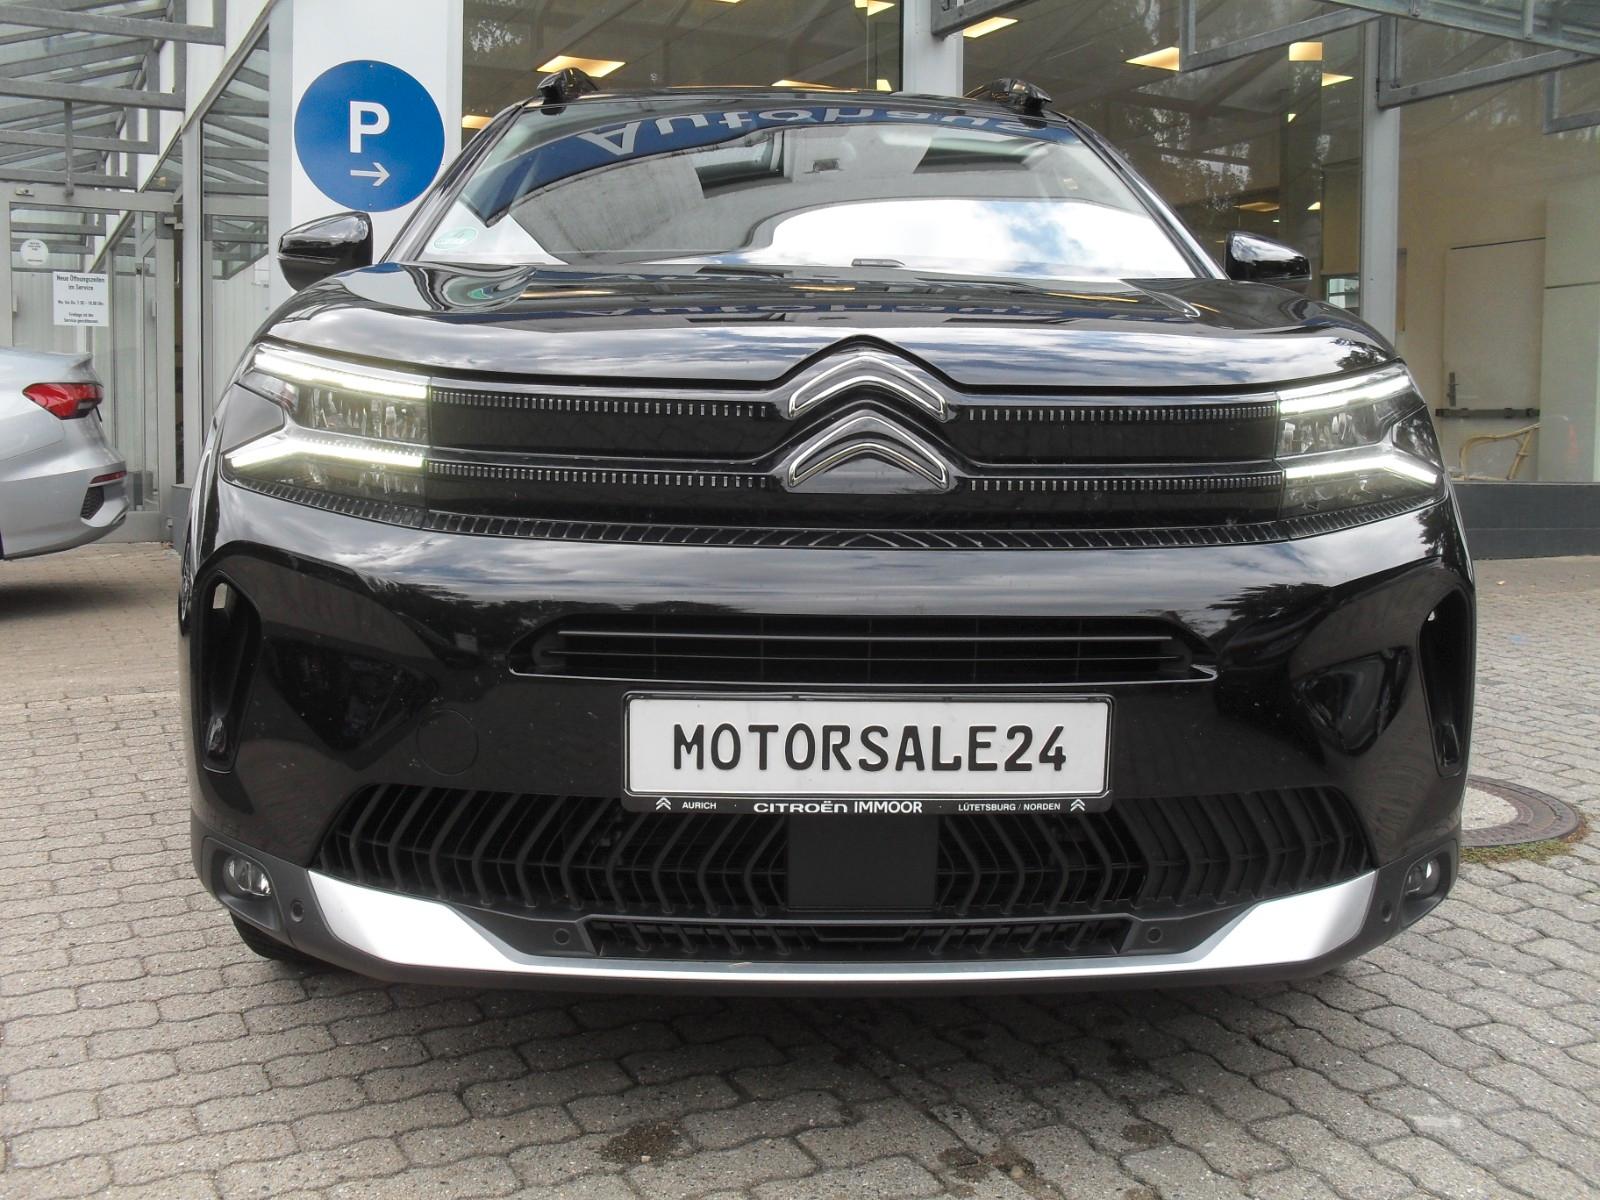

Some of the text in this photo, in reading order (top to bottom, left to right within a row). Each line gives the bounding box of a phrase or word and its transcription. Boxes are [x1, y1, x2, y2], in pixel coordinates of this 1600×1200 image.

[349, 100, 390, 153] P
[673, 723, 1067, 772] MOTORSALE24
[681, 801, 717, 810] AURICH
[854, 801, 923, 813] IMMOOR
[958, 802, 1016, 812] LÜTETSBURG
[1023, 803, 1061, 811] NORDEN
